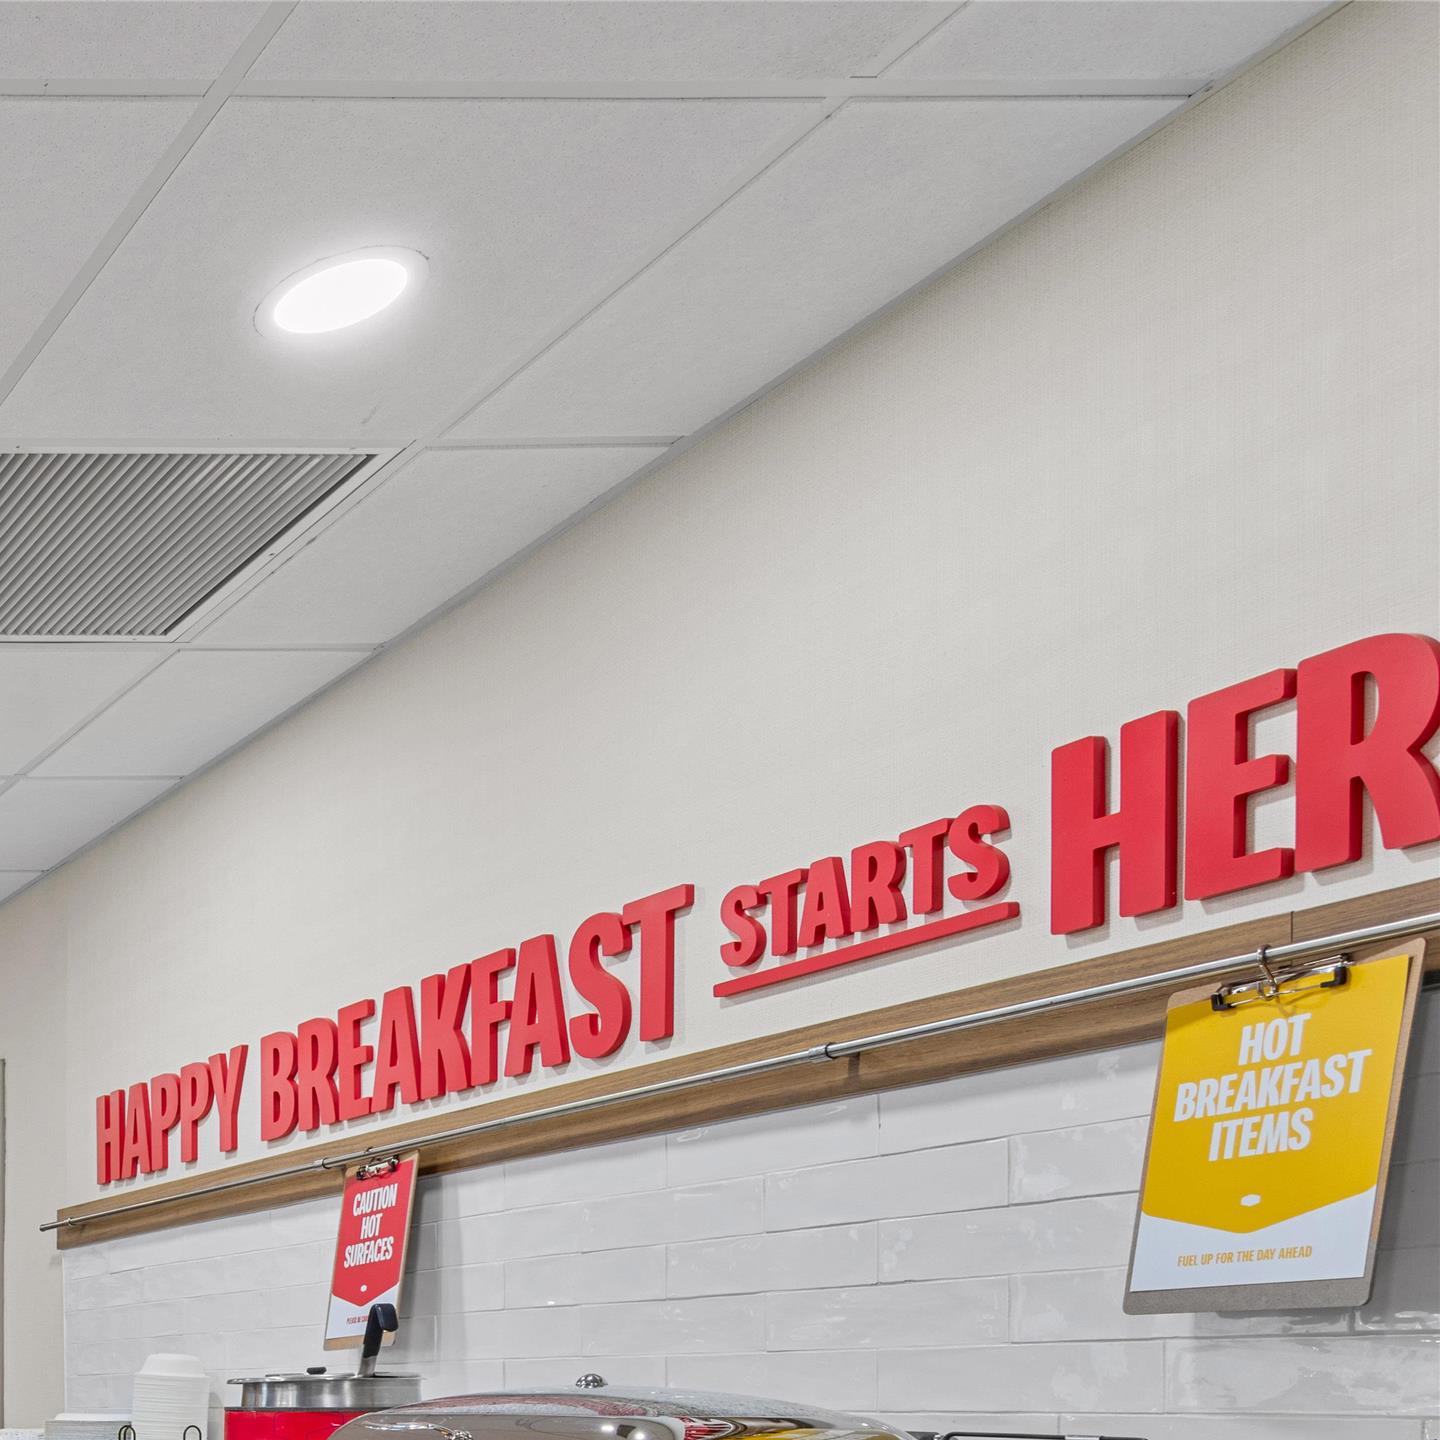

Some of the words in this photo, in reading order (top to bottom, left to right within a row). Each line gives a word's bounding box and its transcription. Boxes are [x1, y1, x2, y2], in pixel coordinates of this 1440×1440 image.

[96, 1044, 249, 1186] HAPPY
[261, 884, 695, 1142] BREAKFAST
[720, 804, 1012, 968] STARTS
[1051, 632, 1440, 936] HER
[1238, 1012, 1313, 1066] HOT
[1173, 1048, 1373, 1122] BREAKFAST
[1208, 1107, 1314, 1162] ITEMS
[352, 1183, 399, 1217] CAUTION
[360, 1213, 383, 1240] HOT
[343, 1236, 395, 1269] SURFACES
[1177, 1254, 1199, 1267] FUEL
[1200, 1253, 1214, 1265] UP
[1216, 1252, 1234, 1264] FOR
[1236, 1250, 1255, 1262] THE
[1256, 1248, 1277, 1261] DAY
[1278, 1245, 1313, 1260] AHEAD
